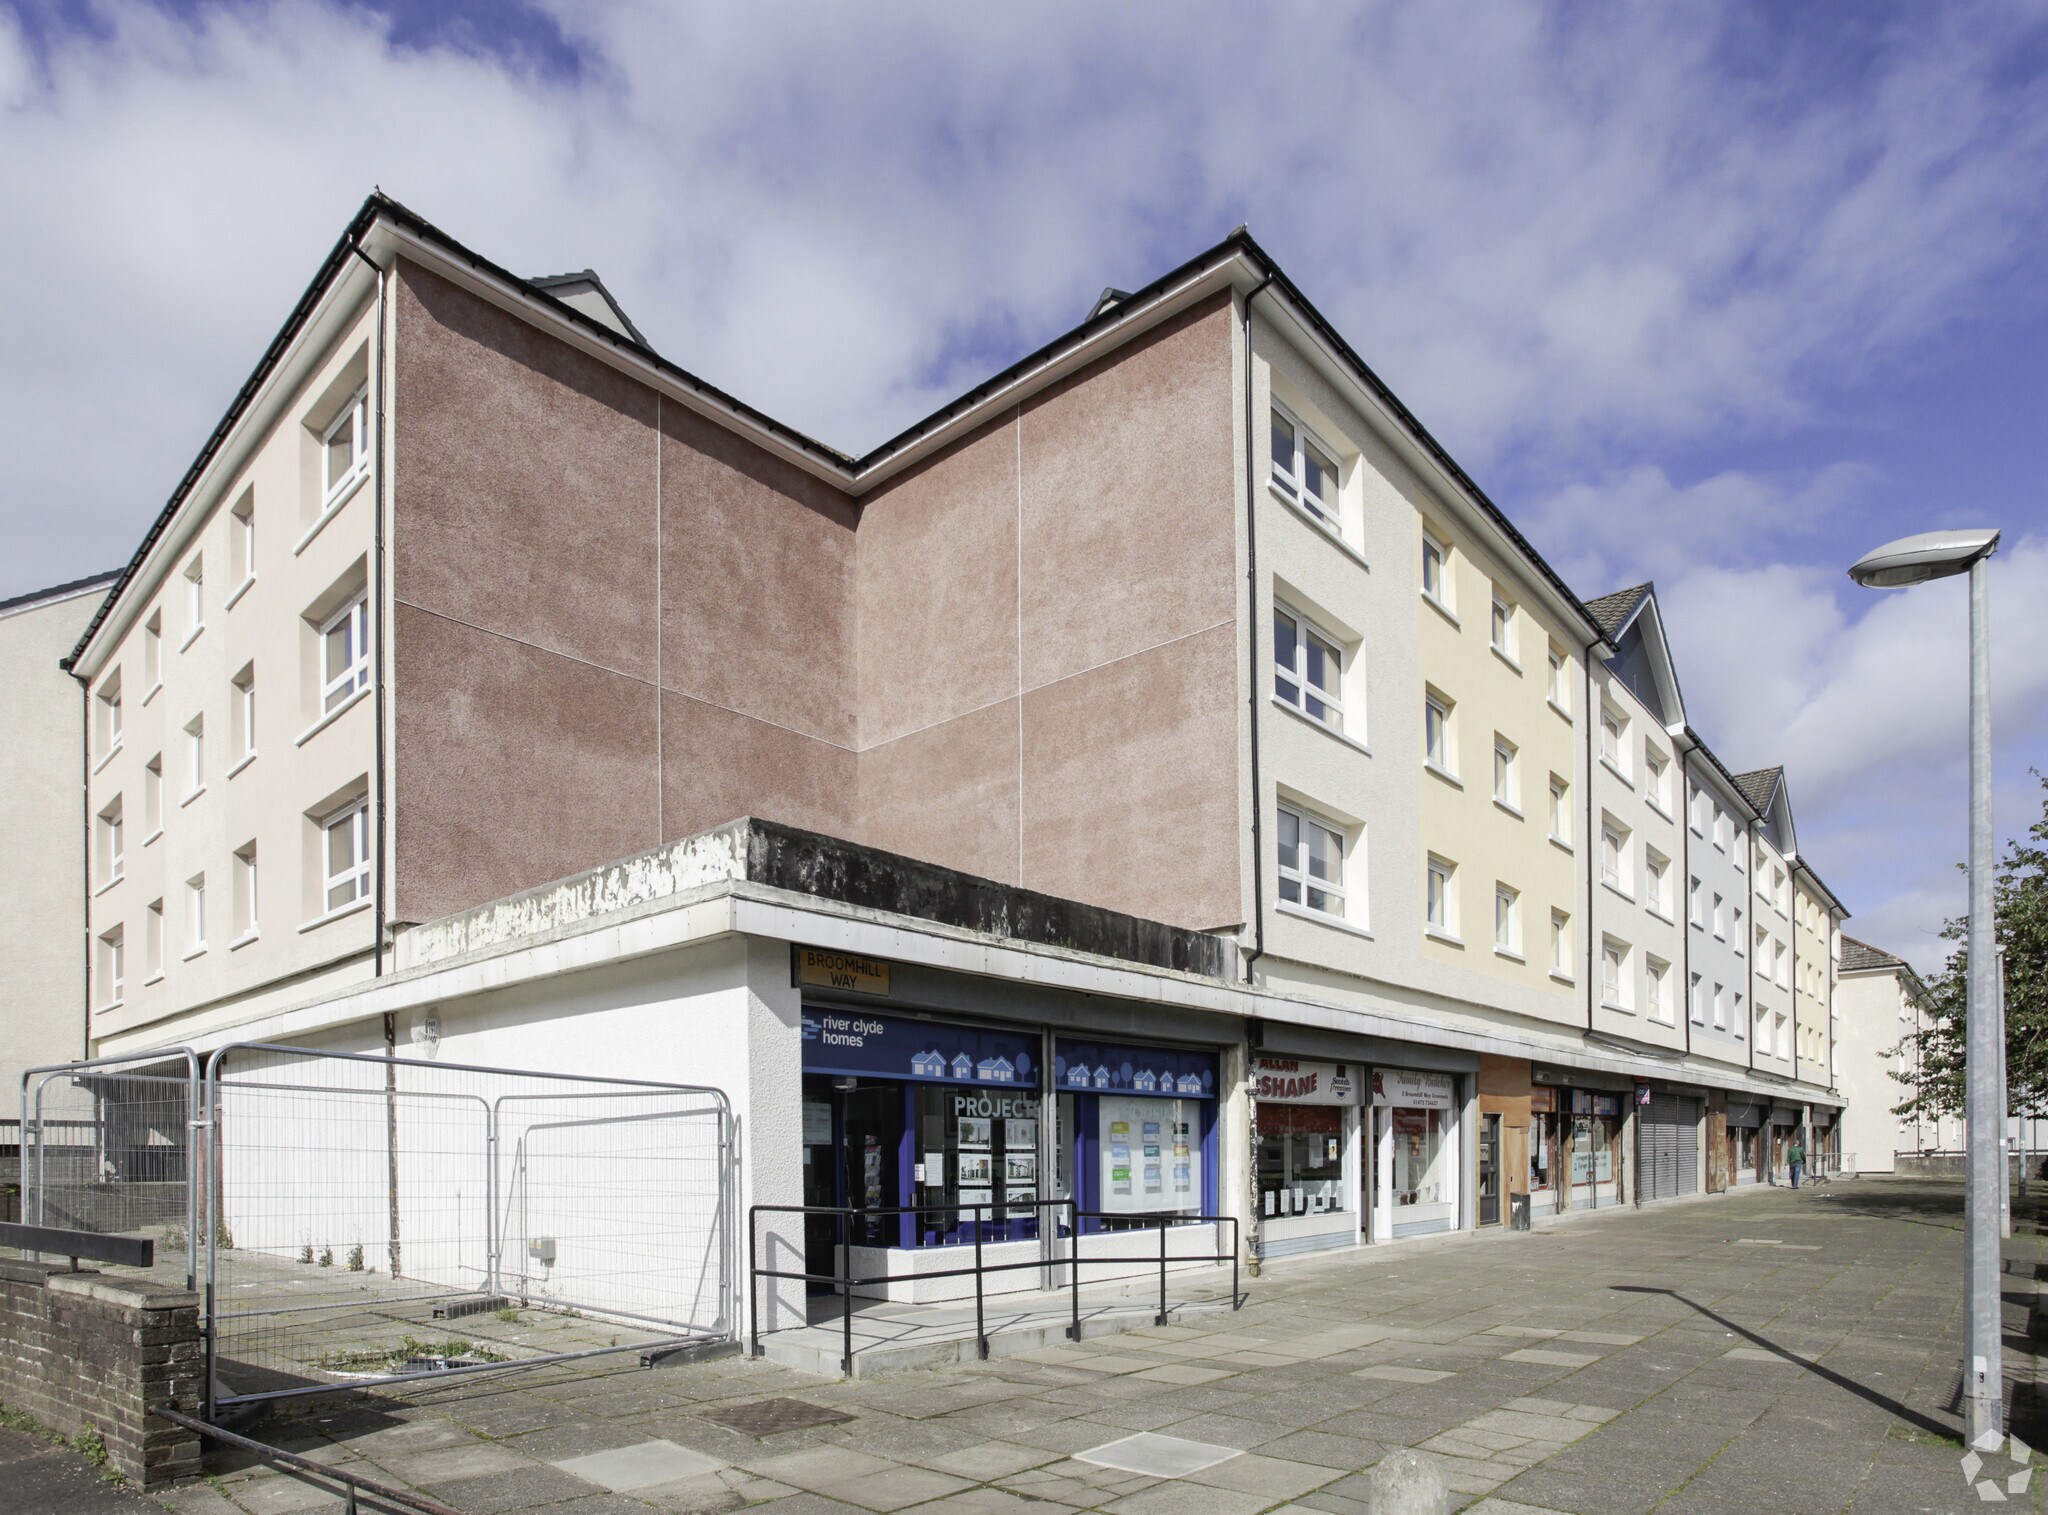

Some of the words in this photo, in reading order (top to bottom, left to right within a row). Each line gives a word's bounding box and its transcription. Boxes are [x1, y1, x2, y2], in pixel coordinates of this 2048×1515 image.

[807, 952, 882, 978] BROOMHILL
[830, 972, 858, 989] WAY
[823, 1015, 851, 1031] river
[853, 1018, 884, 1036] clyde
[823, 1030, 864, 1048] homes
[1258, 1058, 1299, 1073] ALLAN
